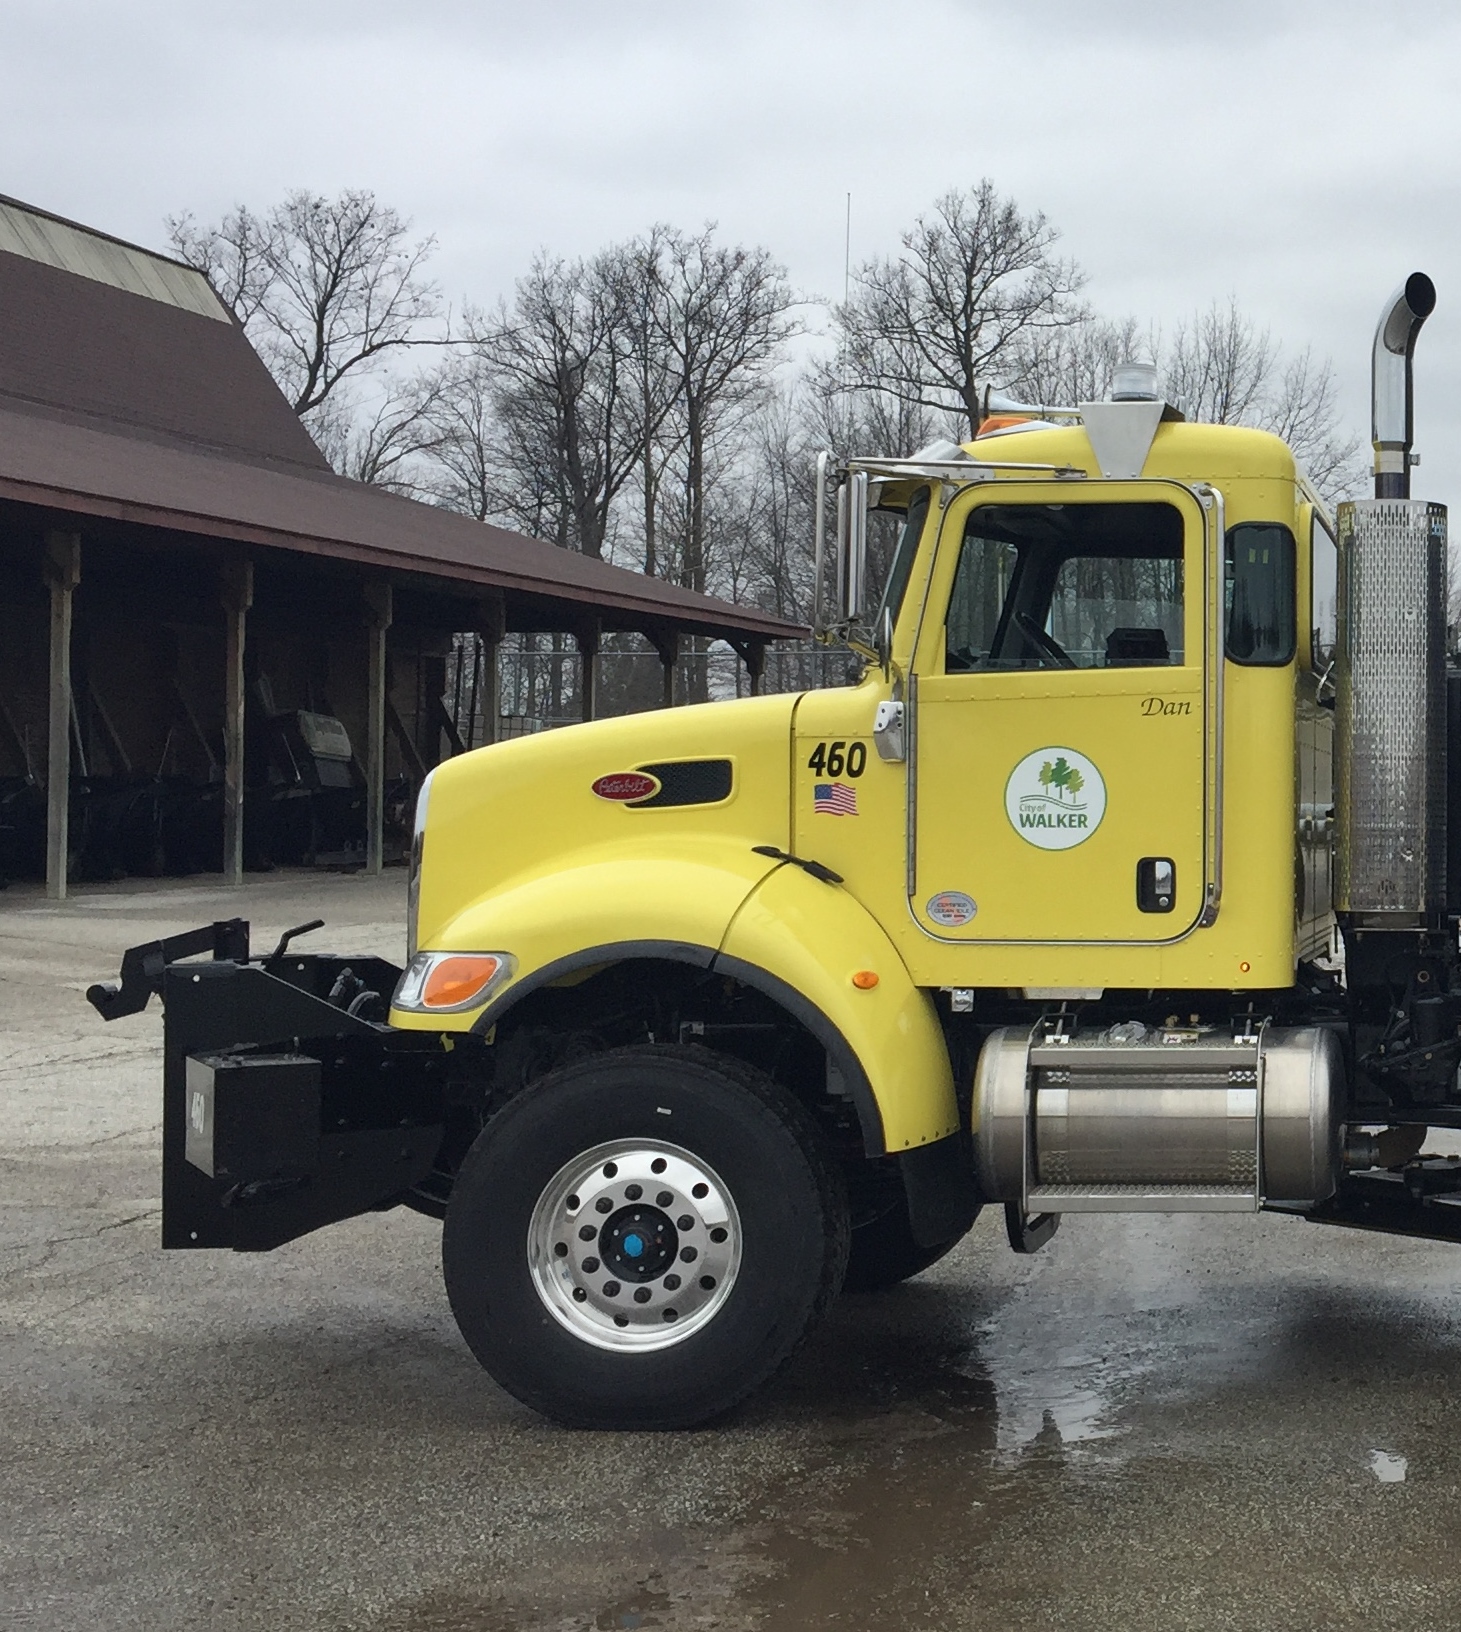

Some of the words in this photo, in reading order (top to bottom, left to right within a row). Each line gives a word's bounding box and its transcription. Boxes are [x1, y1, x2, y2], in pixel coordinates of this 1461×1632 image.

[1141, 697, 1192, 716] Dan
[808, 741, 867, 778] 460
[1019, 803, 1037, 813] City
[1037, 803, 1047, 812] of
[1019, 813, 1088, 829] WALKER
